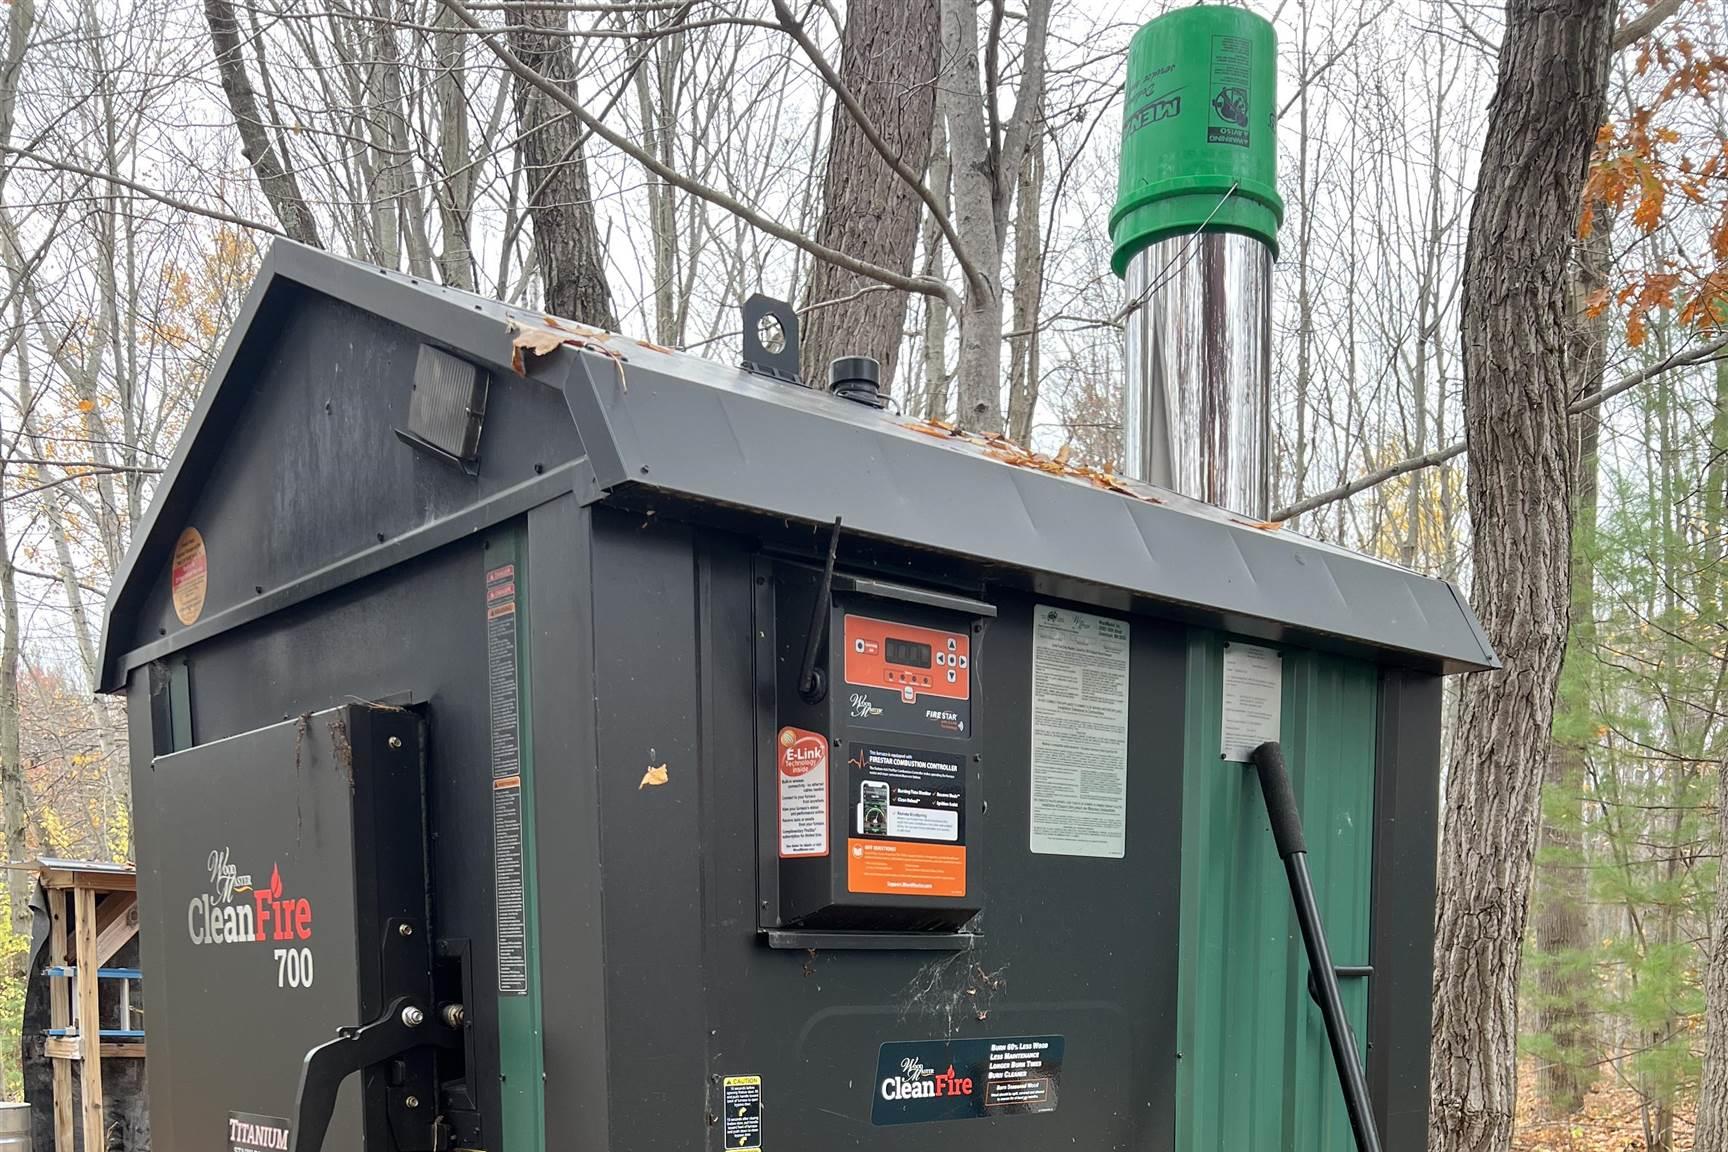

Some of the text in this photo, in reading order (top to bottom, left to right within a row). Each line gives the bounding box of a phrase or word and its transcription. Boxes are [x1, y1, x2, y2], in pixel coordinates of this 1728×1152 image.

[786, 747, 822, 760] E-Link
[869, 756, 957, 771] FIRESTAR COMBUSTION CONTROLLER
[188, 888, 312, 944] CleanFire
[274, 947, 313, 988] 700
[881, 1074, 972, 1100] CleanFire
[229, 1118, 289, 1150] TITANIUM
